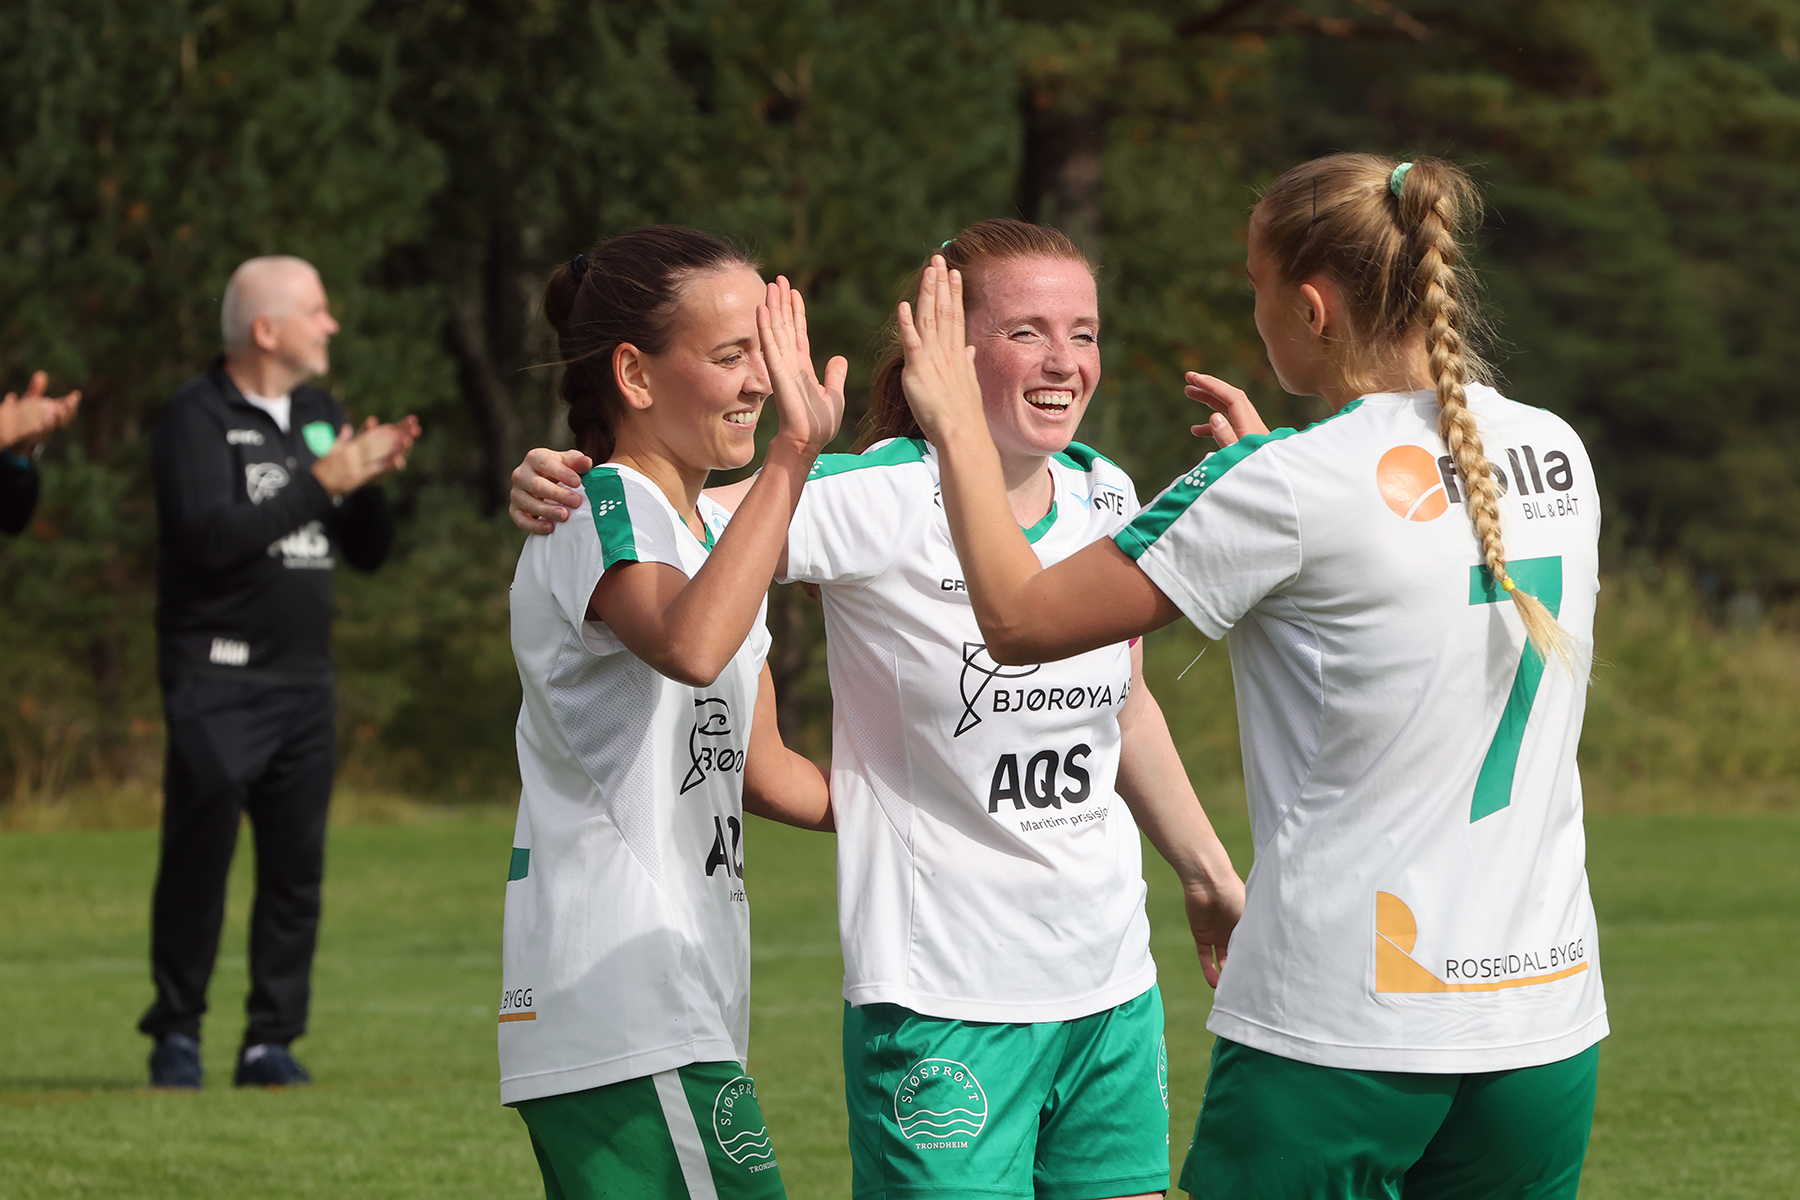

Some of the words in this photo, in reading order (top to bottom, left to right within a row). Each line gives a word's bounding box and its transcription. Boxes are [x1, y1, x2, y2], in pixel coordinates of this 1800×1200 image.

[1523, 502, 1546, 519] BIL
[1548, 504, 1556, 516] &
[1556, 493, 1579, 516] BÅT
[993, 684, 1112, 712] BJØRØYA
[1469, 556, 1562, 824] 7
[988, 743, 1092, 813] AQS
[1020, 816, 1068, 832] Maritim
[1550, 938, 1584, 967] BYGG
[503, 988, 532, 1009] BYGG
[901, 1066, 979, 1104] SJØSPRØYT
[916, 1142, 968, 1150] TRONDHEIM
